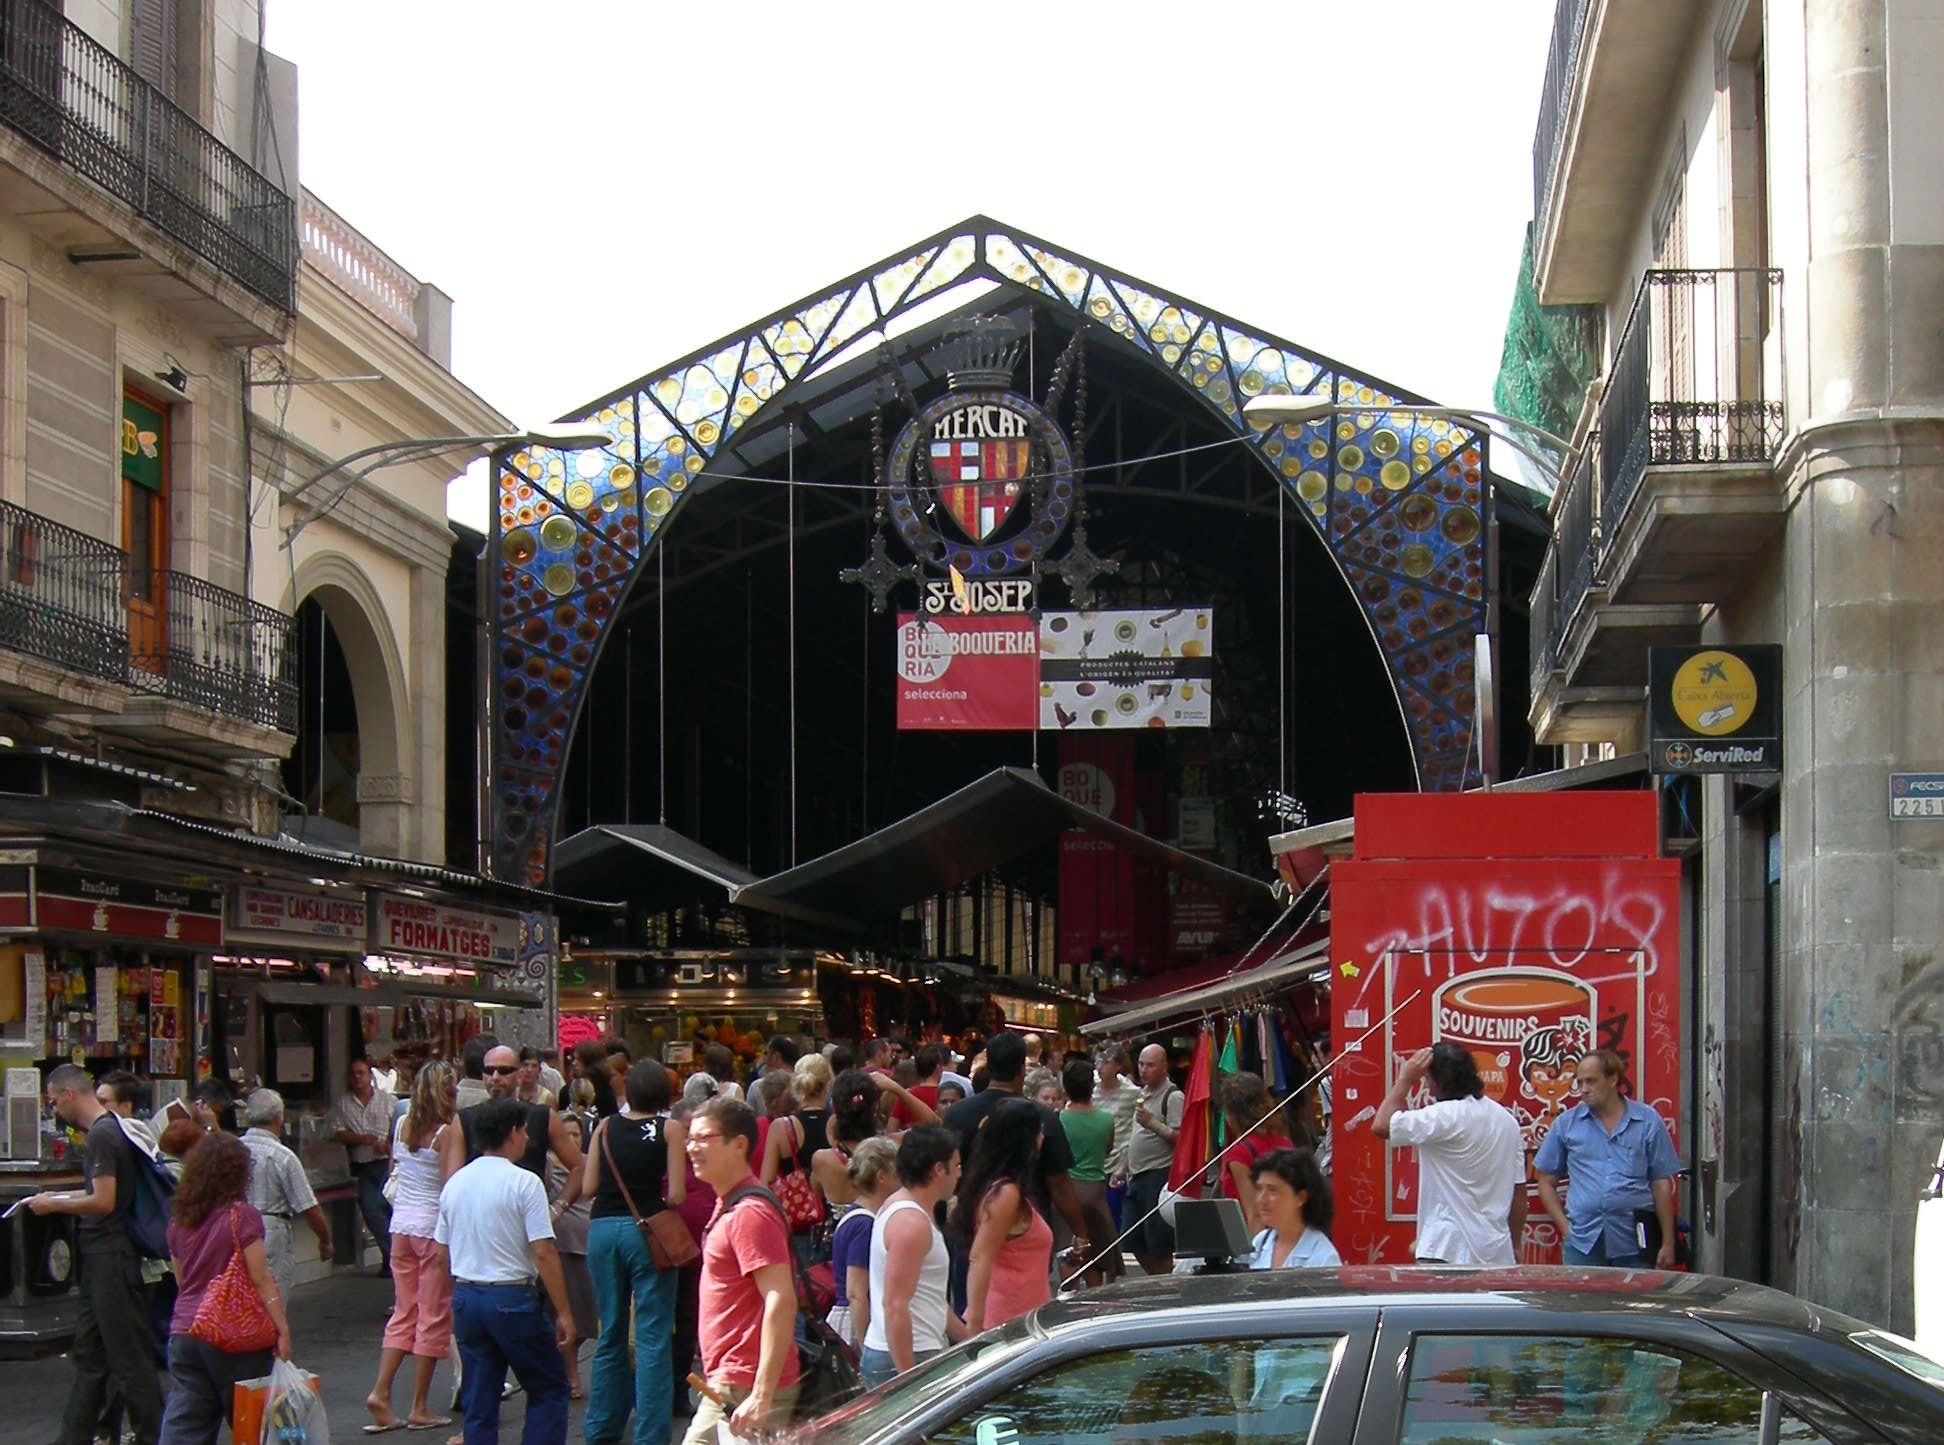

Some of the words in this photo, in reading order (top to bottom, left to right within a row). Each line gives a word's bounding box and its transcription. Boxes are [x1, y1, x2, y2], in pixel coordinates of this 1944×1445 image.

[934, 405, 1028, 440] MERCAT
[950, 580, 1032, 614] JOSEP
[949, 631, 1036, 655] BOQUERIA
[904, 661, 936, 677] RIA
[904, 688, 968, 701] selecciona
[1693, 745, 1764, 764] ServiRed
[1064, 770, 1089, 786] BO
[287, 895, 364, 927] CANSALADERIES
[390, 919, 491, 958] FORMATGES
[1439, 1007, 1539, 1040] SOUVENIRS
